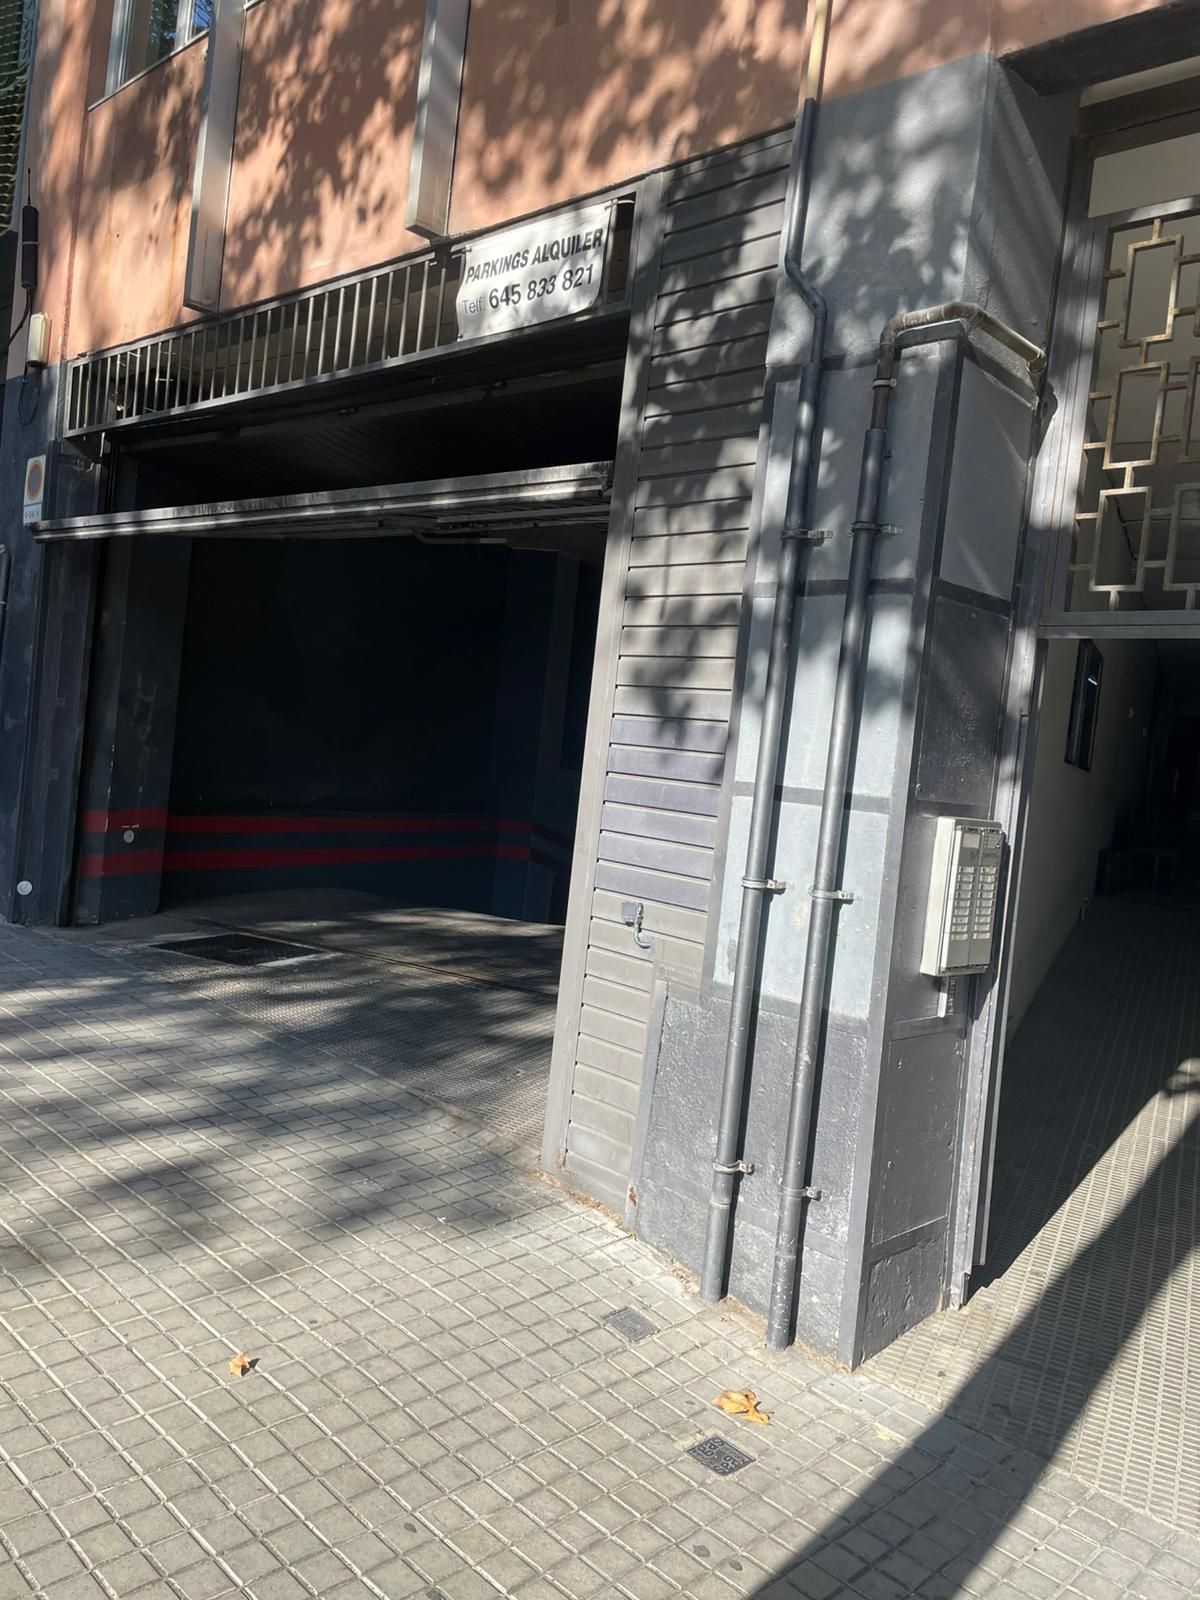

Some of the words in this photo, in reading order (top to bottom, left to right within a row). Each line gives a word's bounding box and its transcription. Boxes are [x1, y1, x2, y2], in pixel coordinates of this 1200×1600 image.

[466, 248, 530, 284] PARKINGS
[531, 228, 604, 266] ALQUILER
[462, 297, 486, 314] Telf.
[489, 283, 522, 310] 645
[527, 274, 557, 301] 833
[562, 263, 594, 291] 821
